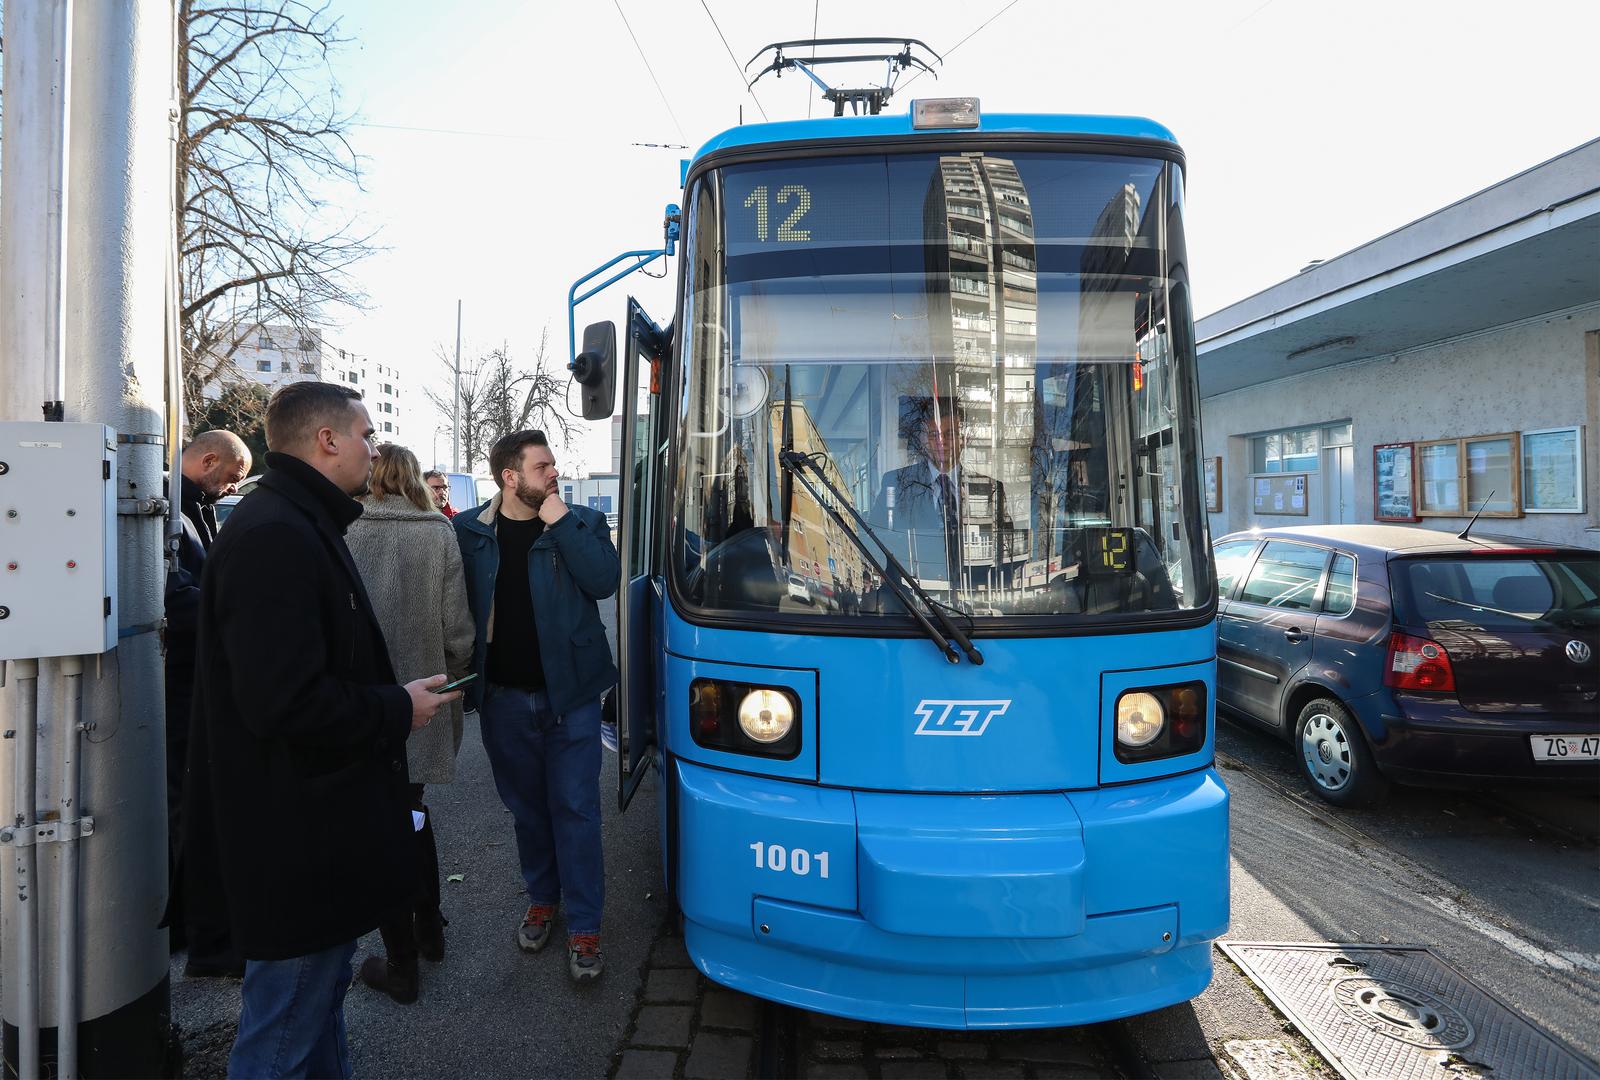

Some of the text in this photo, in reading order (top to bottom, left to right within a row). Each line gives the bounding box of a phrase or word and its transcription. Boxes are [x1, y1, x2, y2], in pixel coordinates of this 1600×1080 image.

[744, 185, 811, 242] 12
[1102, 532, 1127, 569] 12
[914, 699, 1012, 736] ZET
[1544, 738, 1568, 757] ZG
[750, 841, 829, 879] 1001
